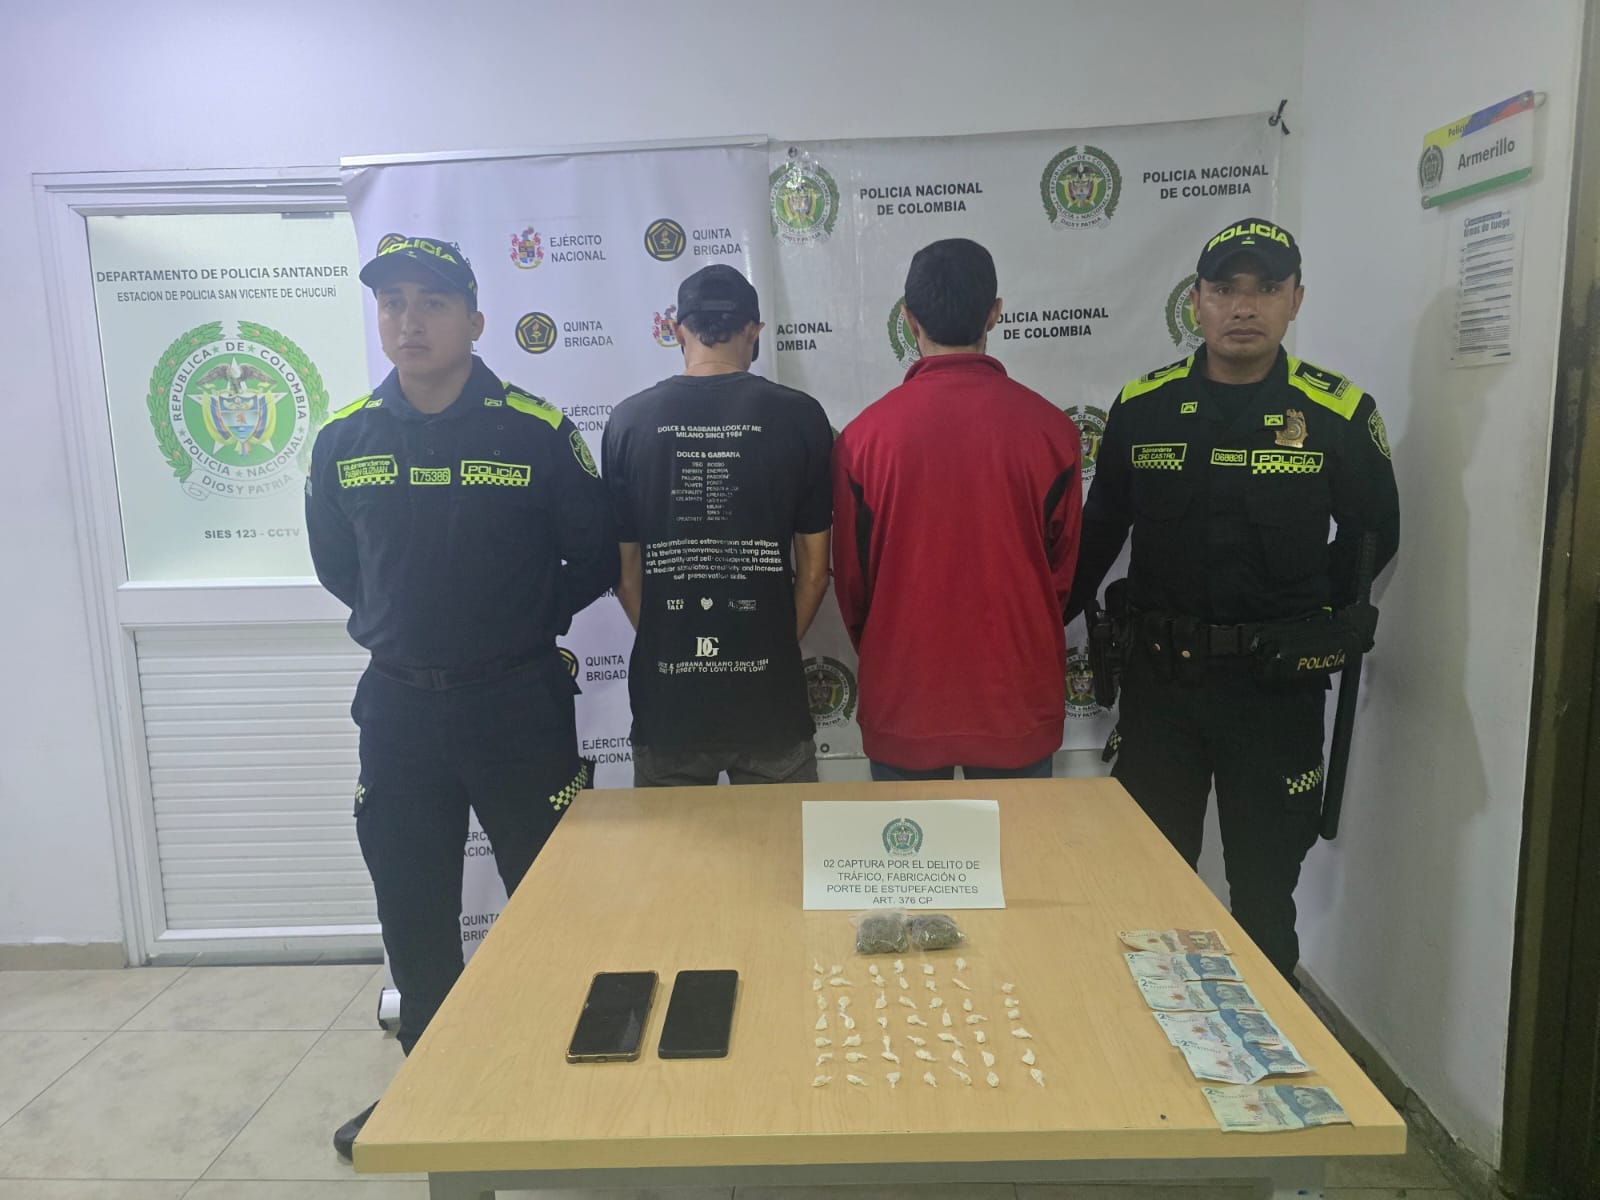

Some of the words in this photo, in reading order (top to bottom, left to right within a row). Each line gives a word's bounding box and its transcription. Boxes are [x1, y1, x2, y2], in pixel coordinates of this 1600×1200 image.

[1457, 136, 1516, 171] Armerillo
[1143, 169, 1197, 184] POLICIA
[1201, 164, 1269, 179] NACIONAL
[860, 185, 912, 200] POLICIA
[916, 182, 983, 197] NACIONAL
[1160, 187, 1178, 200] DE
[1182, 182, 1251, 198] COLOMBIA
[877, 204, 894, 216] DE
[898, 200, 967, 215] COLOMBIA
[549, 233, 602, 247] EJÉRCITO
[692, 228, 732, 241] QUINTA
[693, 243, 742, 256] BRIGADA
[551, 250, 606, 263] NACIONAL
[96, 269, 198, 282] DEPARTAMENTO
[201, 268, 218, 280] DE
[220, 267, 270, 279] POLICIA
[272, 265, 349, 278] SANTANDER
[117, 290, 163, 302] ESTACION
[165, 290, 178, 301] DE
[180, 289, 216, 301] POLICIA
[218, 289, 237, 300] SAN
[239, 288, 278, 299] VICENTE
[280, 288, 293, 298] DE
[1042, 307, 1109, 321] NACIONAL
[563, 320, 604, 333] QUINTA
[776, 321, 833, 335] ACIONAL
[1003, 328, 1021, 340] DE
[1024, 325, 1092, 339] COLOMBIA
[564, 335, 614, 348] BRIGADA
[776, 339, 817, 352] OMBIA
[225, 341, 245, 352] DE
[260, 350, 307, 420] COLOMBIA
[657, 425, 679, 433] DOLCE
[722, 424, 741, 432] LOOK
[676, 431, 704, 439] MILANO
[183, 438, 231, 476] POLICIA
[247, 435, 304, 477] NACIONAL
[1259, 454, 1316, 465] POLICÍA
[468, 465, 523, 478] POLICÍA
[202, 475, 234, 494] DIOS
[236, 485, 245, 495] Y
[248, 474, 294, 494] PATRIA
[204, 530, 232, 539] SIES
[236, 529, 257, 538] 123
[267, 528, 300, 538] CCTV
[695, 636, 720, 657] DG
[585, 655, 625, 667] QUINTA
[735, 659, 755, 667] SINCE
[1296, 649, 1346, 671] POLICÍA
[586, 669, 627, 681] BRIGAD
[583, 749, 632, 764] NACIONA
[823, 859, 835, 868] 02
[837, 859, 885, 869] CAPTURA
[887, 860, 909, 869] POR
[912, 860, 924, 869] EL
[927, 860, 963, 870] DELITO
[966, 860, 981, 870] DE
[837, 871, 884, 883] TRÁFICO,
[887, 871, 956, 882] FABRICACIÓN
[959, 873, 967, 882] O
[826, 884, 862, 893] PORTE
[864, 884, 878, 893] DE
[881, 884, 979, 894] ESTUPEFACIENTES
[872, 896, 896, 905] ART.
[898, 896, 916, 905] 376
[918, 896, 933, 905] CP
